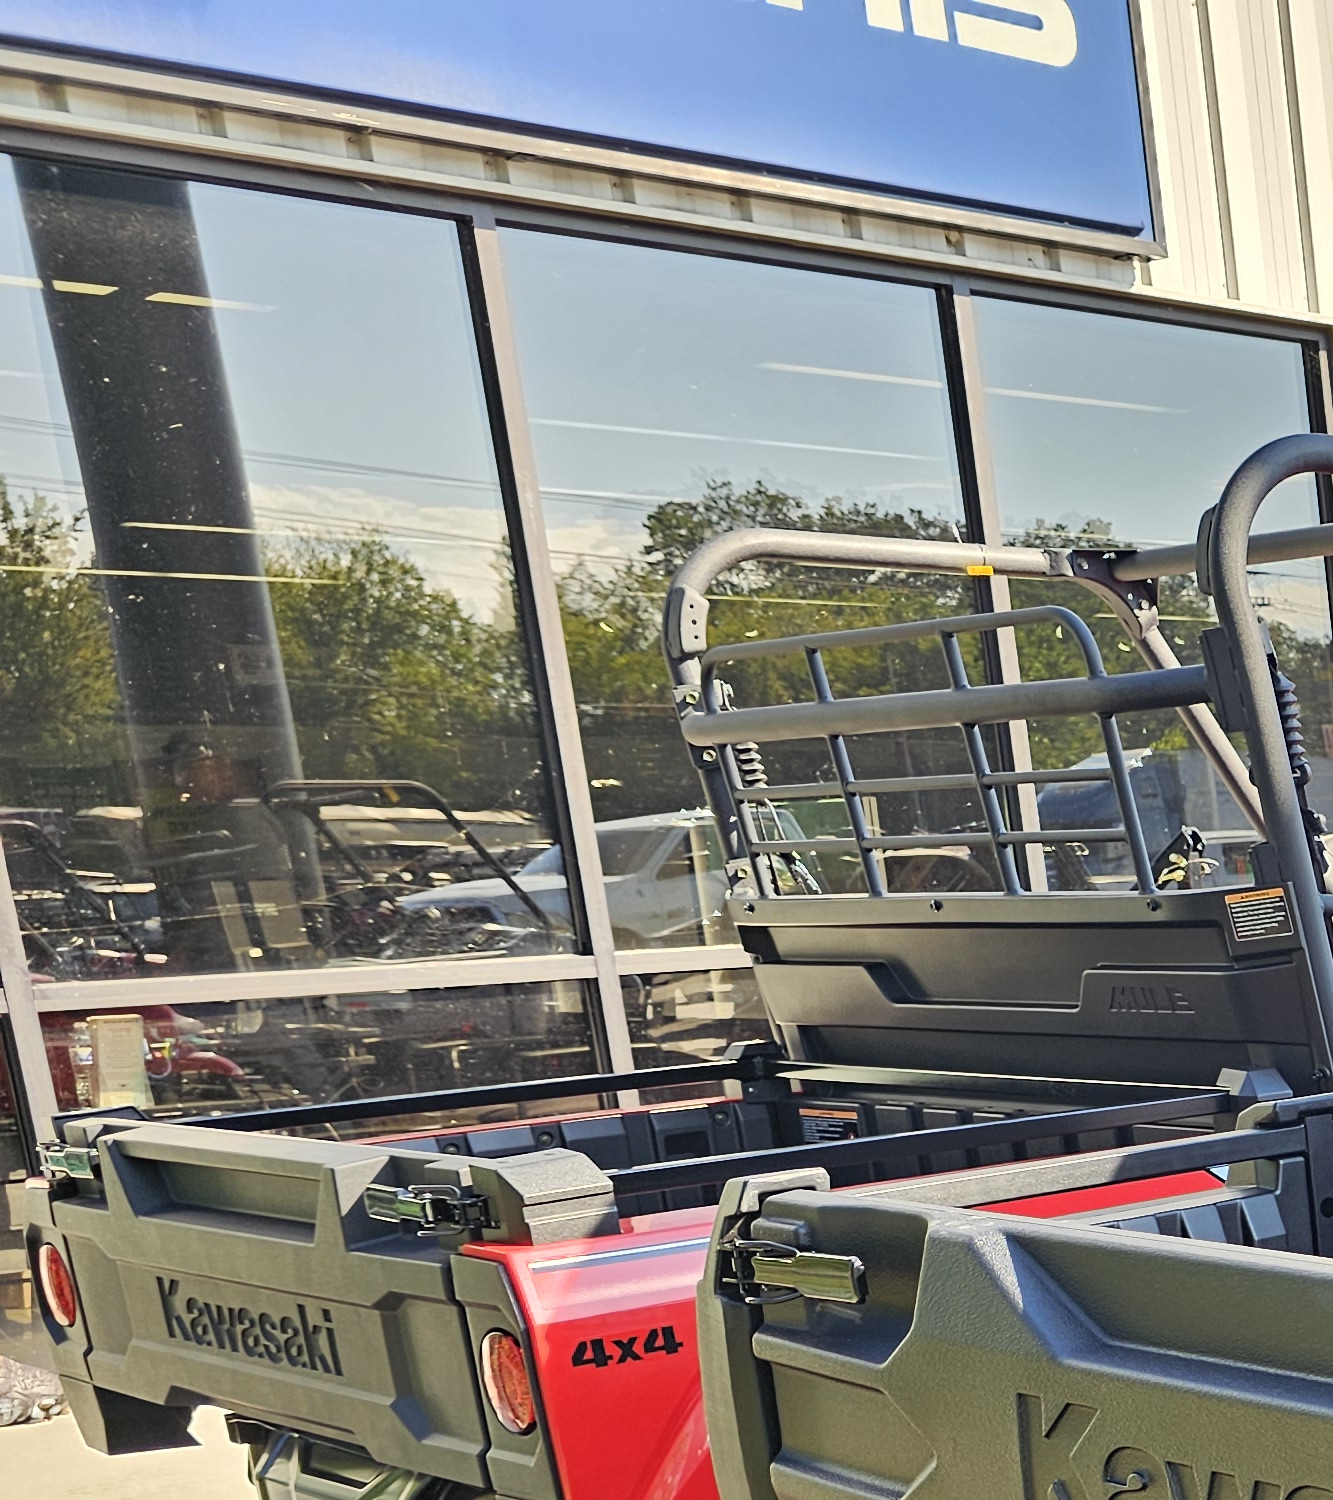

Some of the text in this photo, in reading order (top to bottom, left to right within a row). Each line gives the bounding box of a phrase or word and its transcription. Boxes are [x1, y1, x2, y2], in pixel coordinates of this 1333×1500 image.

[1109, 986, 1195, 1014] MULE
[155, 1275, 344, 1377] Kawasaki
[571, 1325, 684, 1368] 4x4
